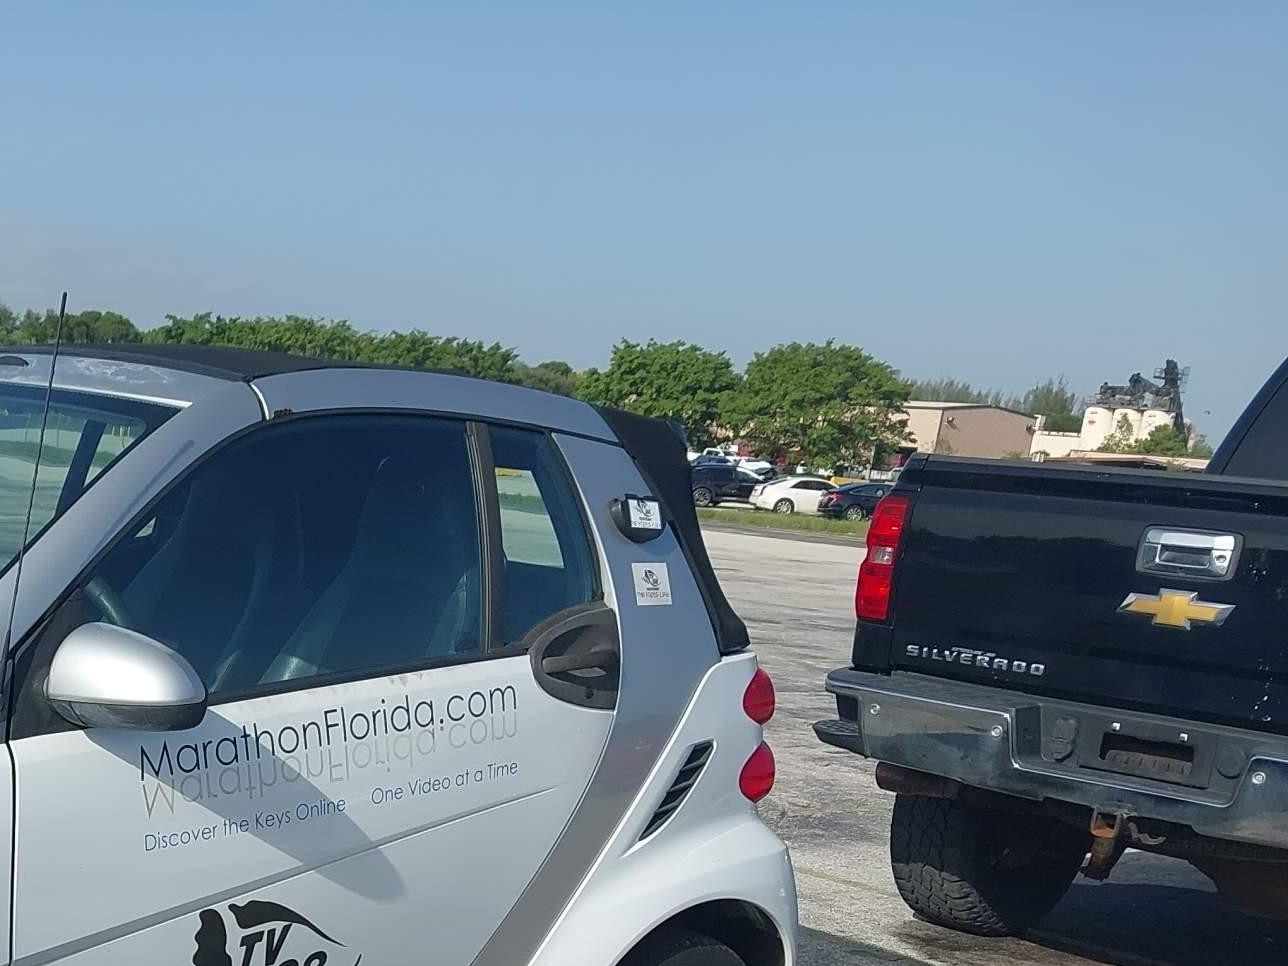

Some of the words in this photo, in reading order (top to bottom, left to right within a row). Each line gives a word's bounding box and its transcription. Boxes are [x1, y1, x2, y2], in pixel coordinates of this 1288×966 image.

[905, 644, 1046, 676] SILVERADO
[140, 685, 518, 781] MarathonFlorida.com
[371, 786, 404, 805] One
[408, 777, 451, 796] Video
[455, 769, 470, 787] at
[473, 770, 483, 783] a
[487, 762, 518, 780] Time
[144, 824, 218, 852] Discover
[223, 818, 250, 836] the
[255, 809, 291, 829] Keys
[295, 798, 346, 821] Online
